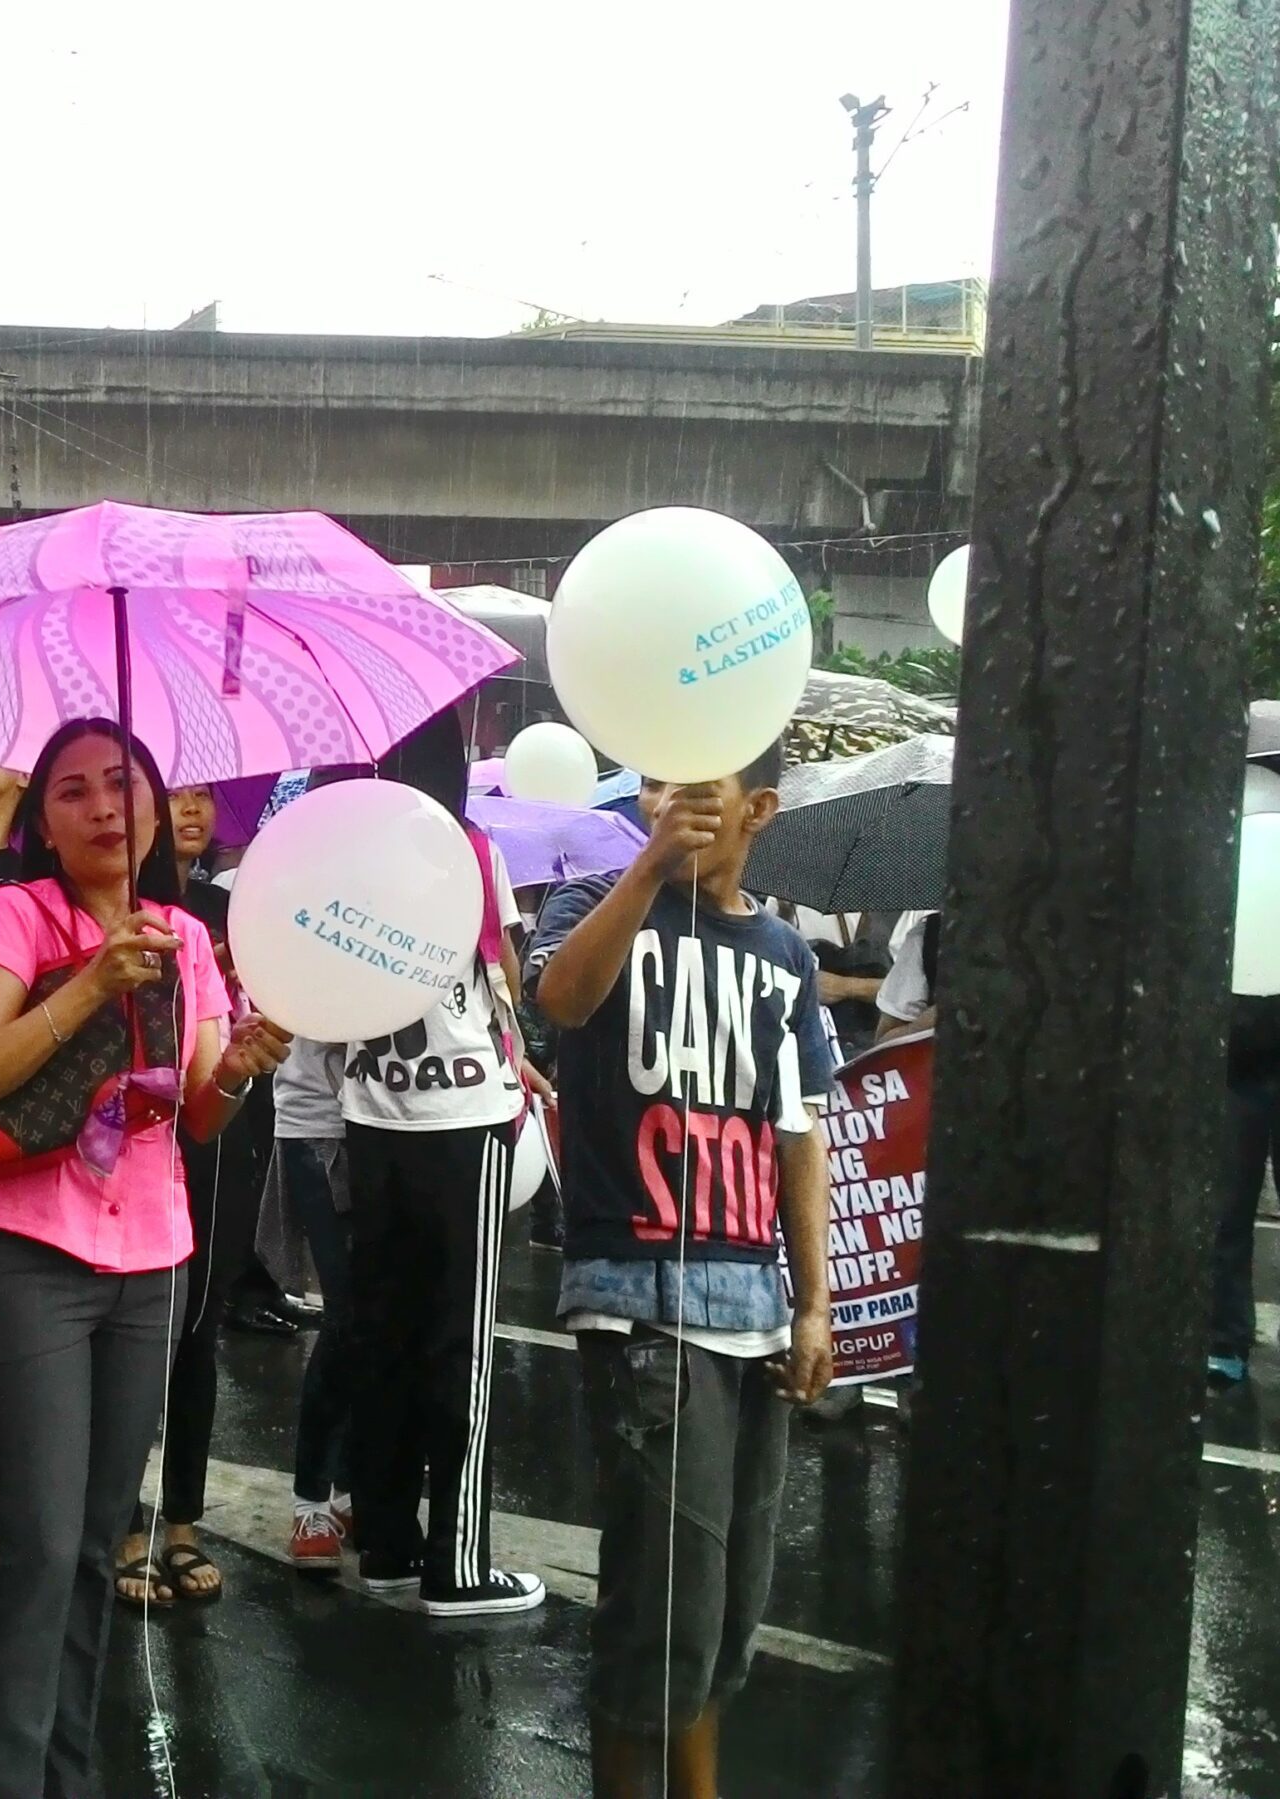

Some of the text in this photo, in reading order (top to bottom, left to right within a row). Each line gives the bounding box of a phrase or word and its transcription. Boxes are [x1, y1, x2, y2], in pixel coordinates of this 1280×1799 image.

[678, 668, 699, 685] &
[703, 620, 792, 677] LASTING
[694, 617, 739, 652] ACT
[744, 598, 780, 626] FOR
[294, 908, 456, 989] & LASTING PEACE
[325, 900, 458, 966] ACT FOR JUST
[628, 929, 807, 1130] CAN'T
[861, 1069, 910, 1106] SA
[879, 1208, 922, 1247] NG
[870, 1292, 914, 1319] PARA
